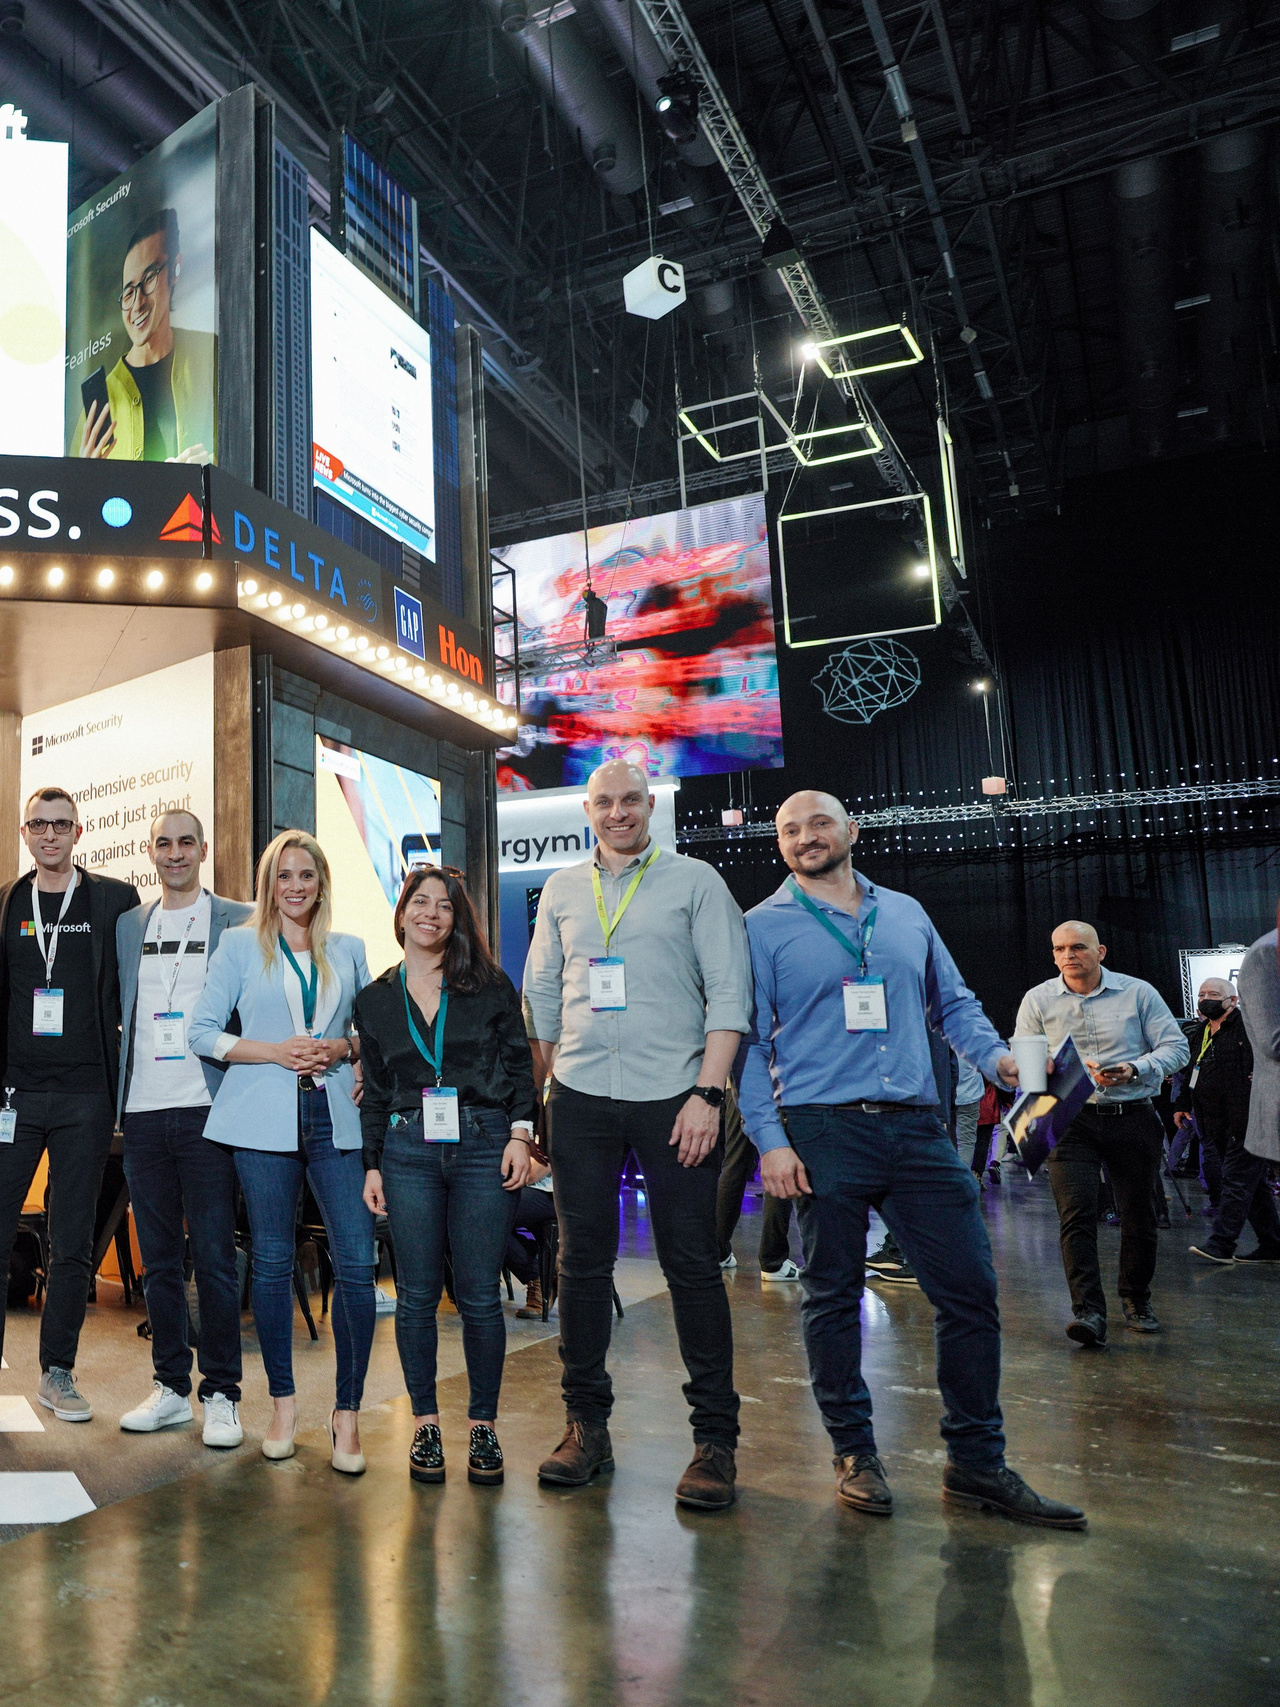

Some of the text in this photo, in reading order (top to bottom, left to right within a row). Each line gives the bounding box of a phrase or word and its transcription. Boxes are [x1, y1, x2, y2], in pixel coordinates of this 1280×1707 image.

[66, 181, 132, 239] crosoft Security
[657, 263, 681, 293] C
[314, 460, 334, 481] NEWS
[315, 448, 331, 467] LIVE
[233, 509, 348, 607] DELTA
[400, 603, 420, 643] GAP
[438, 624, 484, 685] Hon
[45, 713, 124, 749] Microsoft Security
[71, 759, 194, 805] prehensive security
[86, 815, 95, 833] is
[98, 811, 120, 831] not
[121, 803, 147, 831] just
[90, 838, 136, 867] against
